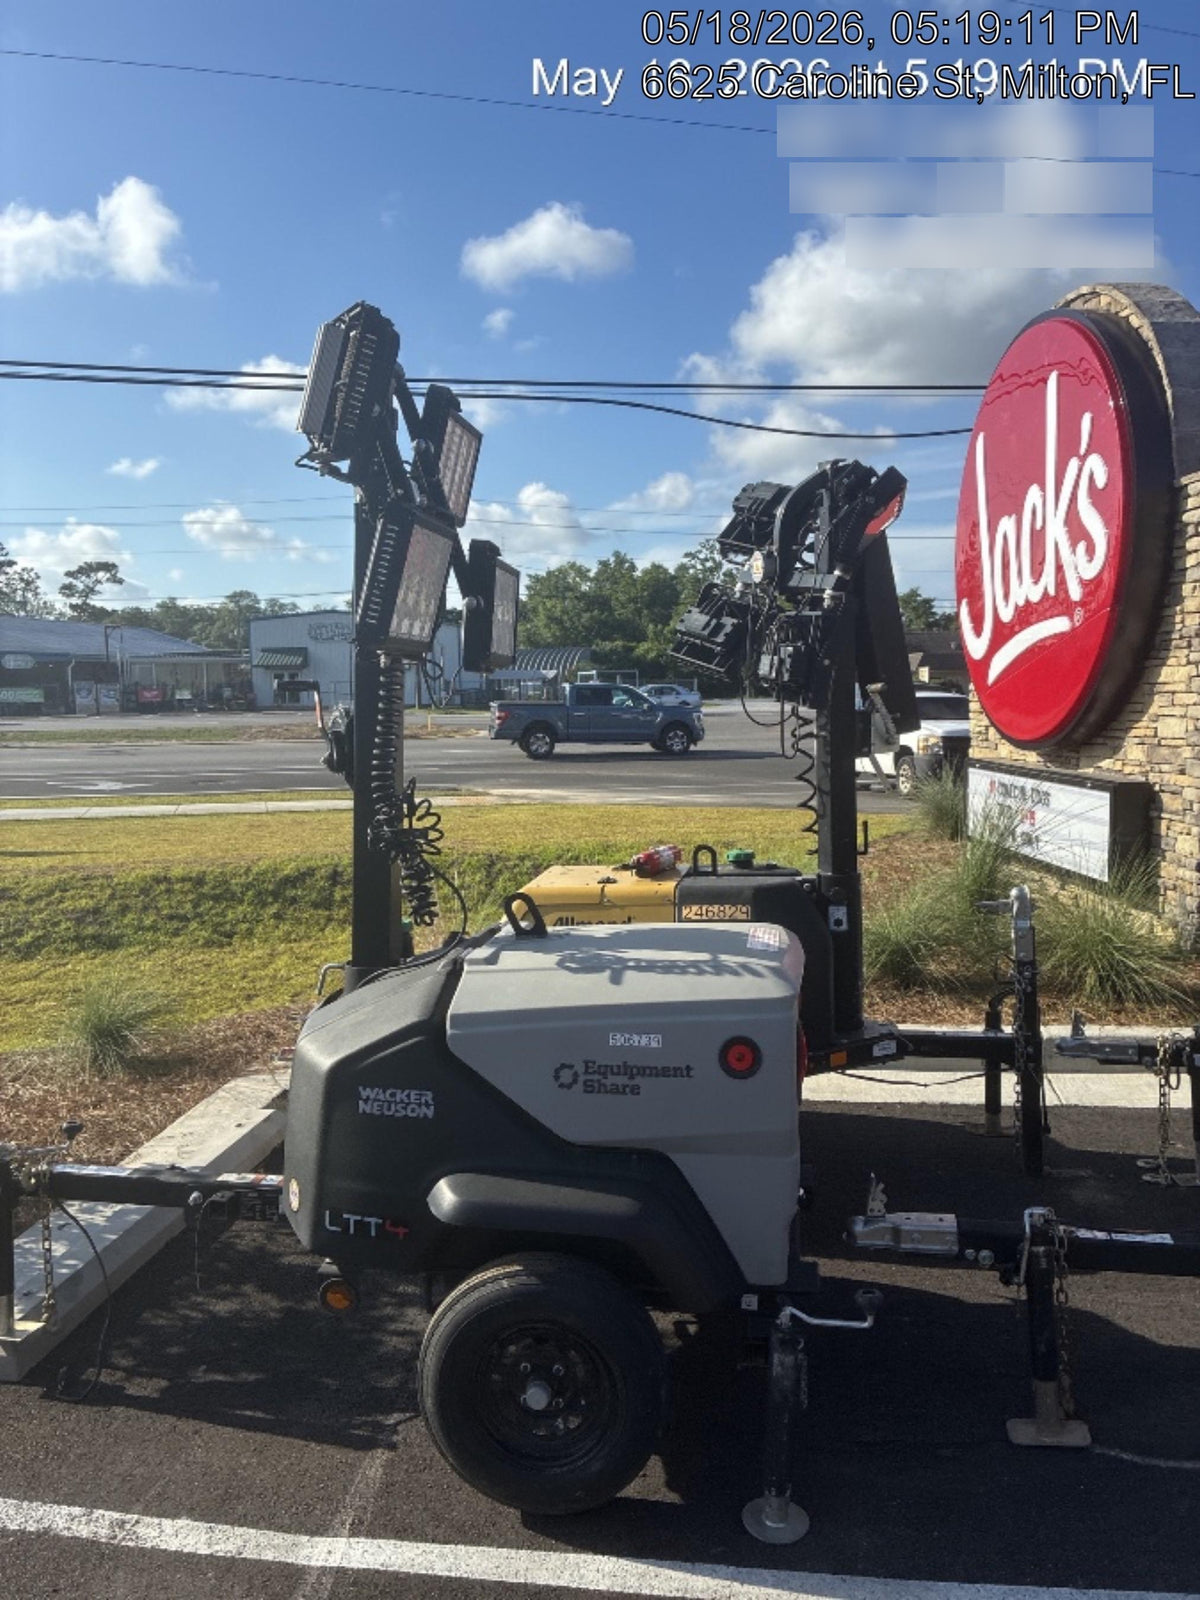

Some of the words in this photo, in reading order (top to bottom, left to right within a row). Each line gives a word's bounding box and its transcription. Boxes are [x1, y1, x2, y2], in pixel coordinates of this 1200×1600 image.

[960, 370, 1109, 660] Jack's
[683, 905, 750, 920] 246829
[583, 1060, 695, 1080] Equipment
[359, 1086, 434, 1104] WACKER
[583, 1079, 641, 1096] Share
[359, 1100, 435, 1119] NEUSON
[325, 1210, 409, 1239] LTT4
